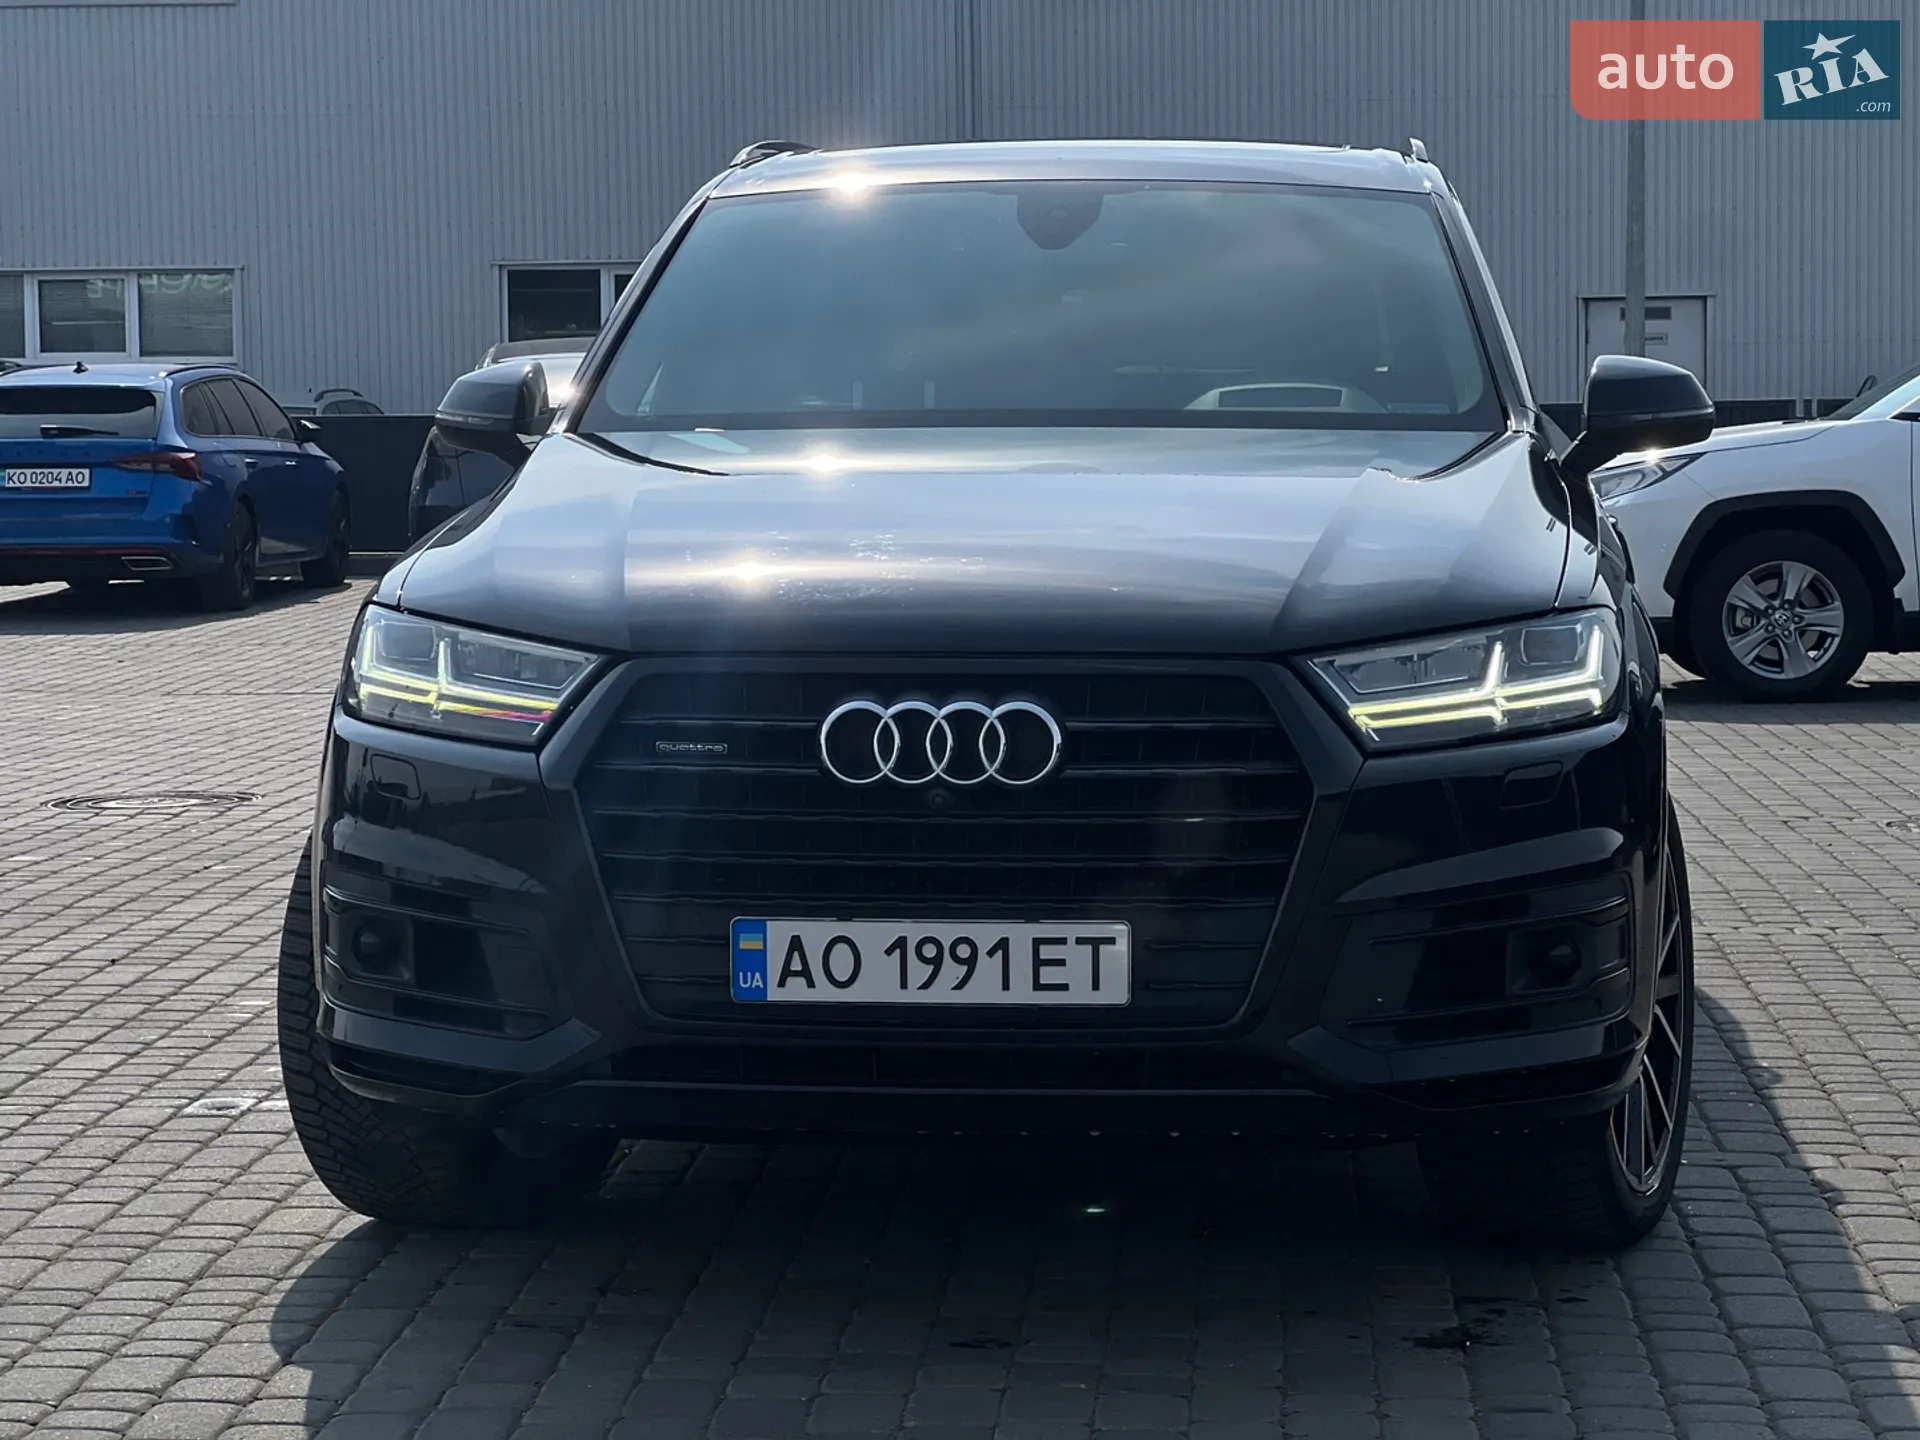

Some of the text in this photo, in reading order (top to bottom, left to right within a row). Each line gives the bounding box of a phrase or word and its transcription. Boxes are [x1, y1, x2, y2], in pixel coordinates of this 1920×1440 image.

[6, 471, 86, 485] KO 0204 AO
[659, 743, 724, 752] quattro
[777, 934, 862, 990] AO
[739, 971, 764, 989] UA
